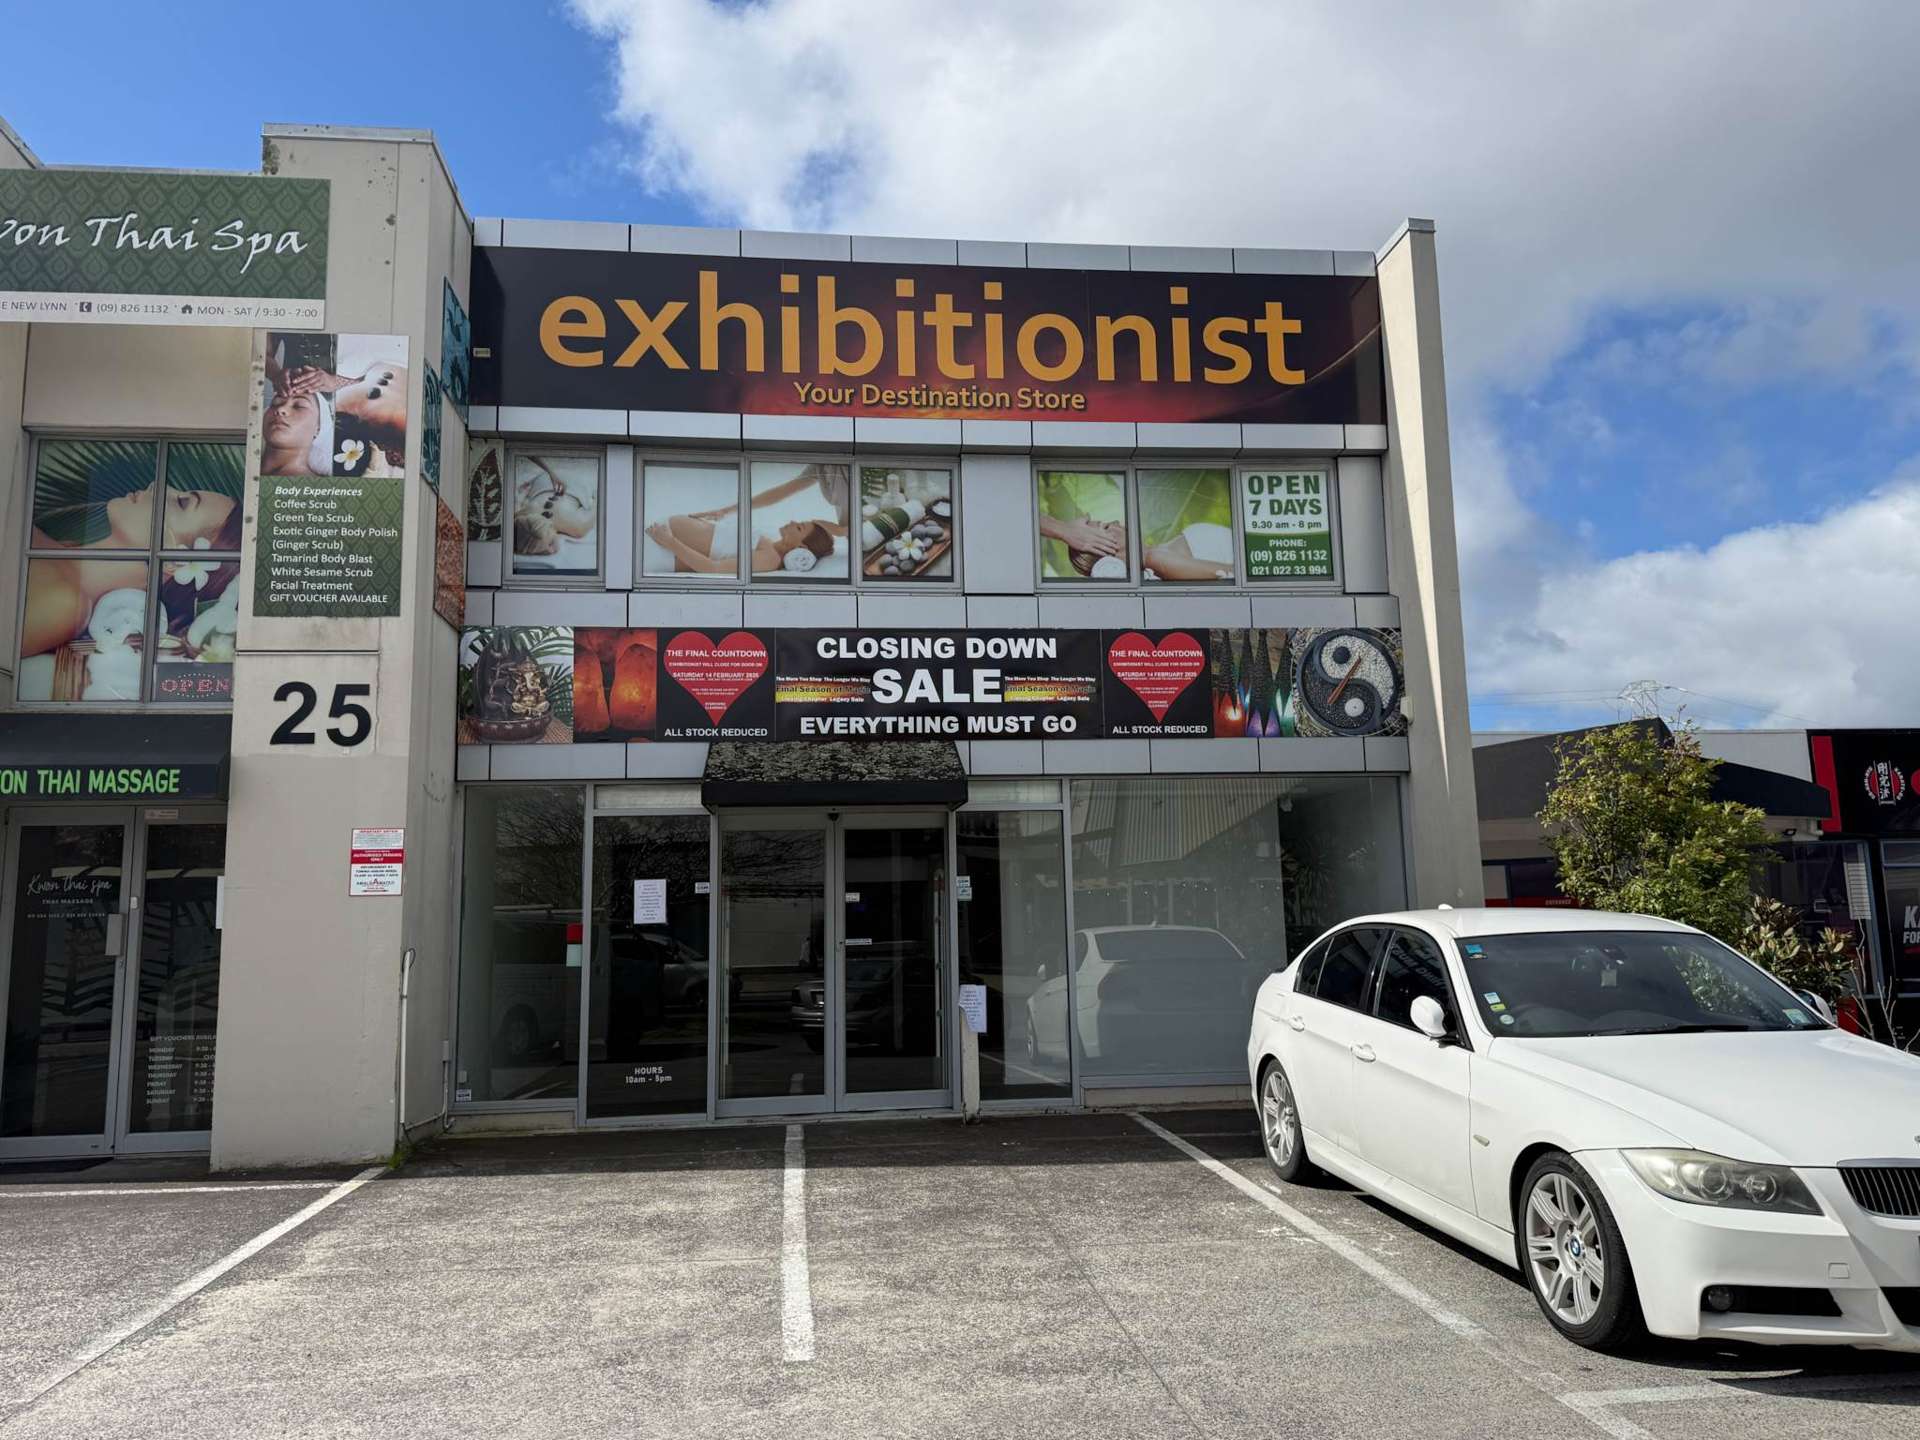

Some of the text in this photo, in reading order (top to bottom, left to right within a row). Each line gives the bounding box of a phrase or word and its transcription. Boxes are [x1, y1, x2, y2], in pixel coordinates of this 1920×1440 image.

[85, 213, 199, 250] Thai
[211, 219, 308, 274] Spa
[10, 301, 37, 310] NEW
[40, 302, 67, 311] LYNN
[97, 303, 117, 313] (09)
[120, 304, 140, 313] 826
[144, 305, 168, 313] 1132
[197, 306, 225, 315] MON
[234, 307, 252, 316] SAT
[262, 308, 286, 317] 9:30
[539, 270, 1306, 385] exhibitionist
[793, 381, 1086, 410] Your Destination Store
[1248, 475, 1320, 495] OPEN
[274, 486, 362, 497] Body Experiences
[274, 499, 337, 509] Coffee Scrub
[1248, 498, 1322, 516] 7 DAYS
[273, 513, 354, 523] Green Tea Scrub
[1307, 521, 1322, 530] pm
[273, 526, 398, 538] Exotic Ginger Body Polish
[272, 540, 344, 551] (Ginger Scrub)
[271, 553, 373, 565] Tamarind Body Blast
[1250, 550, 1328, 564] (09) 826 1132
[271, 567, 373, 577] White Sesame Scrub
[1251, 566, 1270, 575] 021
[1273, 566, 1292, 575] 022
[1294, 566, 1306, 575] 33
[270, 581, 353, 590] Facial Treatment
[269, 594, 388, 603] GIFT VOUCHER AVAILABLE
[667, 649, 683, 657] THE
[711, 650, 766, 658] COUNTDOWN
[816, 637, 1057, 659] CLOSING DOWN
[1128, 650, 1150, 658] FINAL
[1151, 650, 1203, 658] COUNTDOWN
[161, 679, 229, 693] OPEN
[799, 685, 832, 693] Season
[871, 668, 1002, 704] SALE
[269, 681, 372, 747] 25
[799, 715, 1077, 735] EVERYTHING MUST GO
[1112, 725, 1208, 734] ALL STOCK REDUCED
[664, 728, 768, 737] ALL STOCK REDUCED
[0, 768, 180, 794] ON THAI MASSAGE
[1904, 905, 1920, 928] K
[634, 1066, 663, 1075] HOURS
[625, 1076, 646, 1084] 10am
